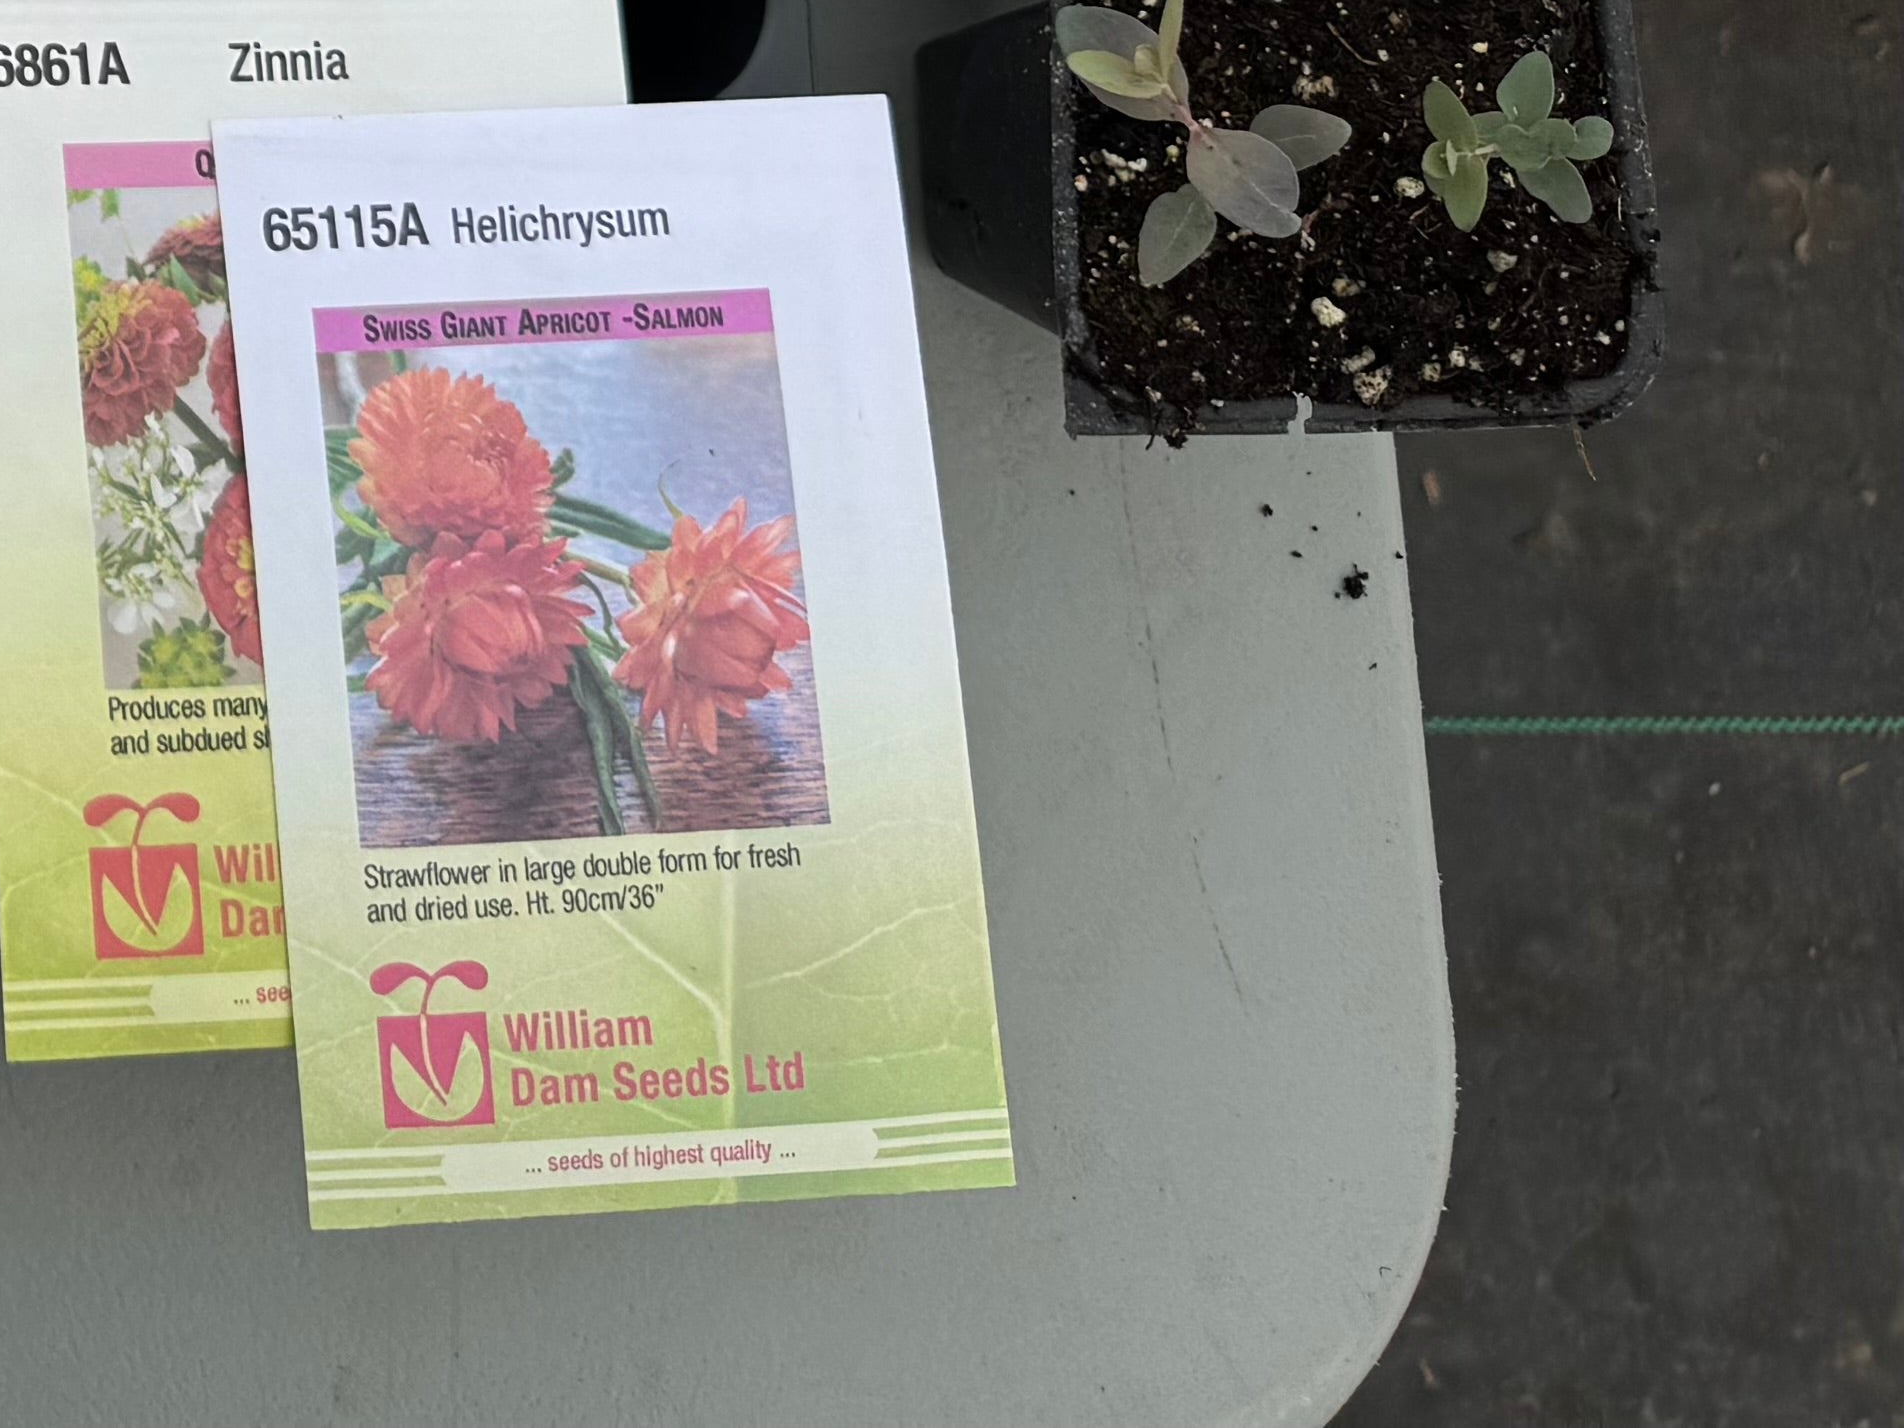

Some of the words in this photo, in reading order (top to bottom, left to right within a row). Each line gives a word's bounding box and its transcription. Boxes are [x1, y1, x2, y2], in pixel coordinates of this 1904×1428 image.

[226, 38, 350, 84] Zinnia
[261, 200, 431, 254] 65115A
[450, 202, 671, 249] Helichrysum
[362, 313, 432, 344] SWISS
[440, 310, 508, 340] GIANT
[518, 308, 612, 336] APRICOT
[108, 695, 206, 722] Produces
[212, 695, 268, 722] many
[110, 729, 150, 756] and
[156, 724, 248, 754] subdued
[364, 862, 492, 891] Strawflower
[498, 859, 518, 884] in
[524, 856, 577, 886] large
[583, 851, 652, 879] double
[657, 848, 708, 874] form
[713, 845, 742, 871] for
[747, 842, 802, 870] fresh
[366, 897, 408, 924] and
[414, 893, 469, 921] dried
[475, 896, 520, 919] use.
[526, 890, 556, 916] Ht.
[502, 1008, 654, 1053] William
[510, 1066, 600, 1107] Dam
[612, 1056, 731, 1102] Seeds
[744, 1050, 806, 1094] Ltd
[547, 1148, 604, 1172] seeds
[610, 1145, 629, 1168] of
[633, 1142, 704, 1170] highest
[710, 1138, 772, 1167] quality
